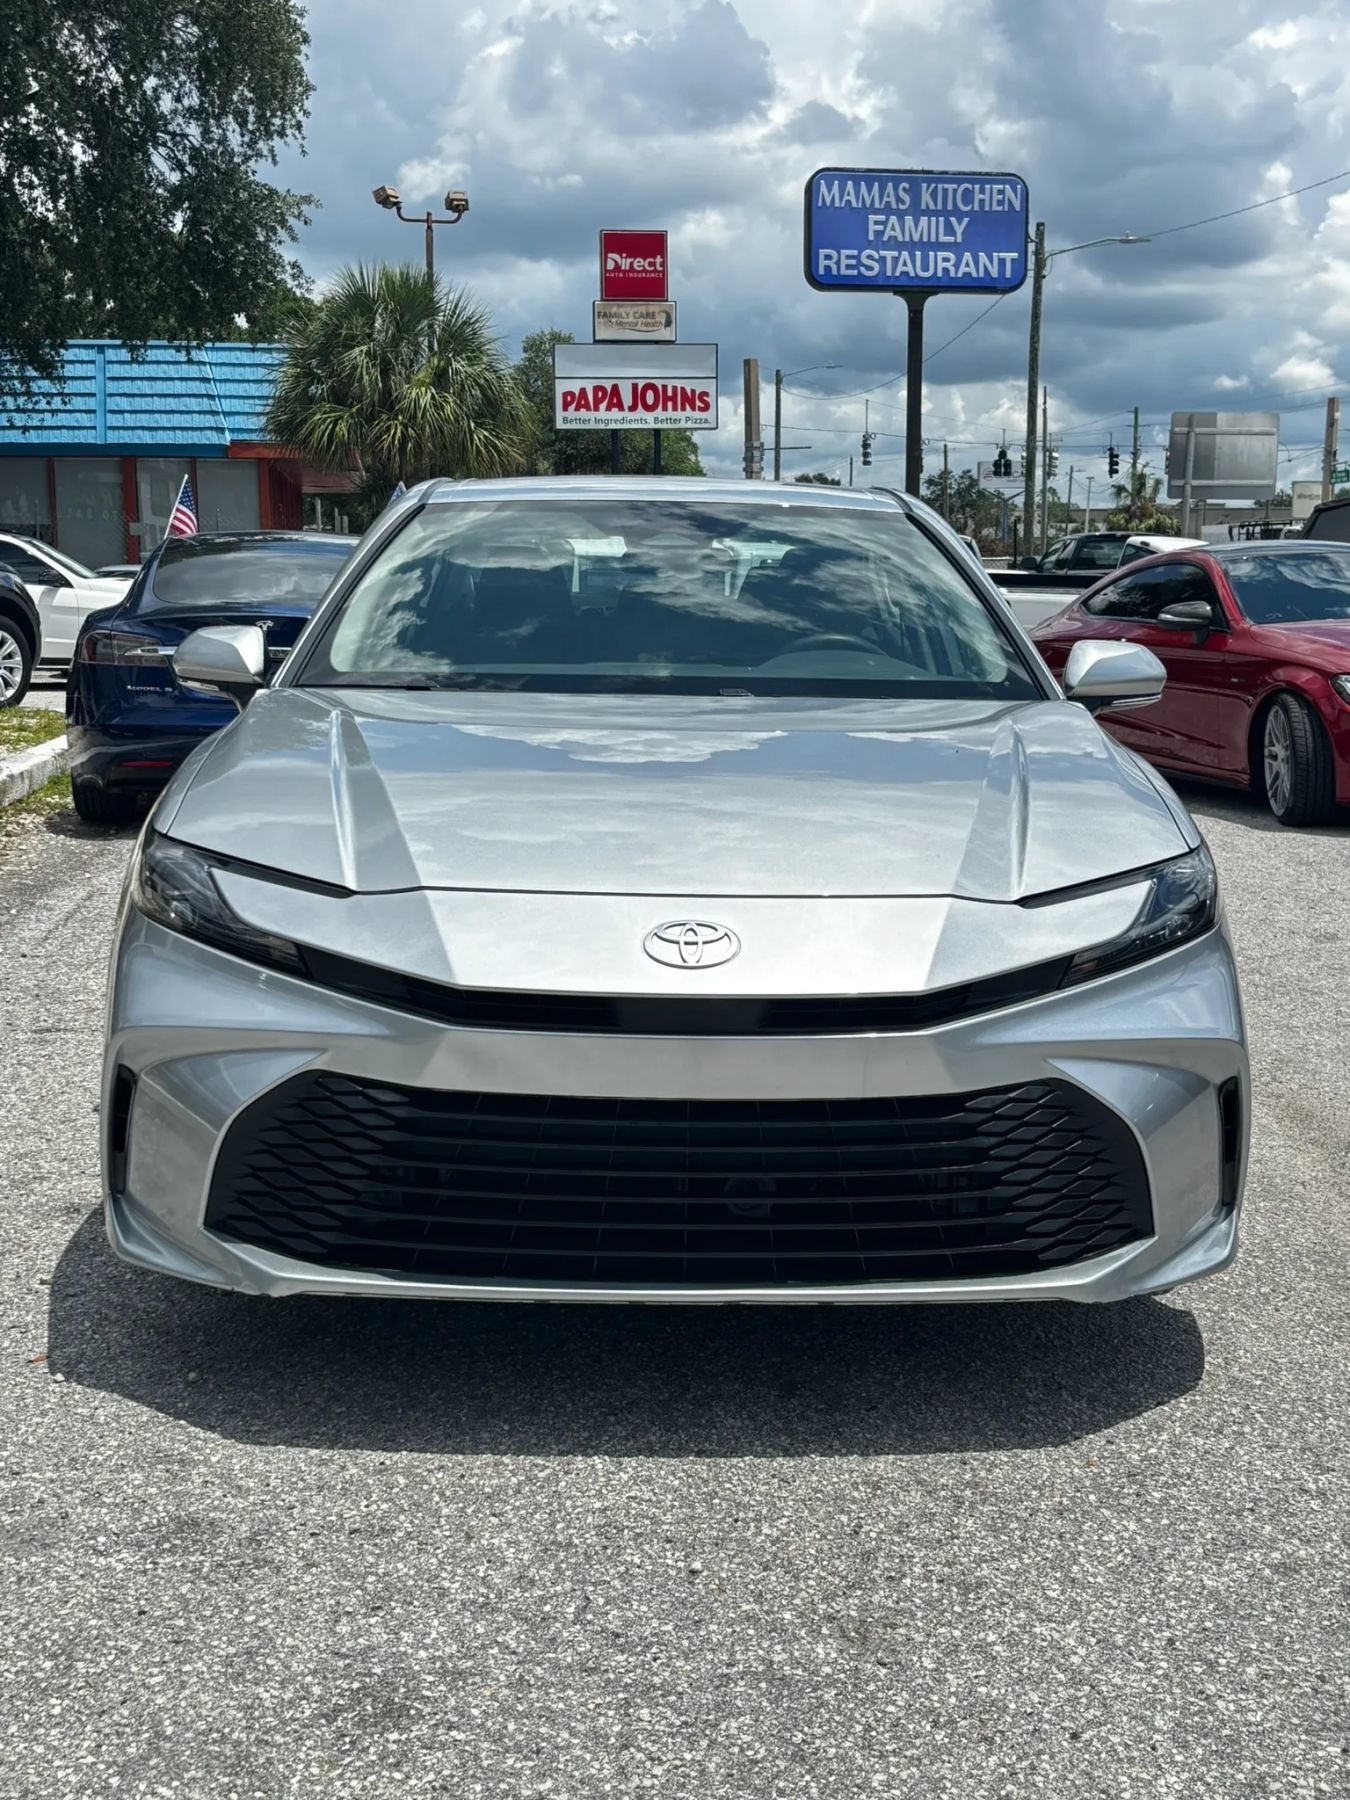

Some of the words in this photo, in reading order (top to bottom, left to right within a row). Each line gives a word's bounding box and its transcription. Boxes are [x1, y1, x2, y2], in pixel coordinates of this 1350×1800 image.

[817, 180, 911, 210] MAMAS
[920, 183, 1021, 212] KITCHEN
[867, 214, 970, 243] FAMILY
[606, 253, 664, 271] Direct
[818, 248, 1019, 279] RESTAURANT
[597, 311, 631, 320] FAMILY
[632, 311, 657, 320] CARE
[614, 320, 639, 328] Mental
[640, 320, 664, 328] Health
[562, 416, 591, 425] Better
[594, 416, 651, 427] Ingredients.
[653, 416, 682, 425] Better
[685, 416, 712, 425] Pizza.
